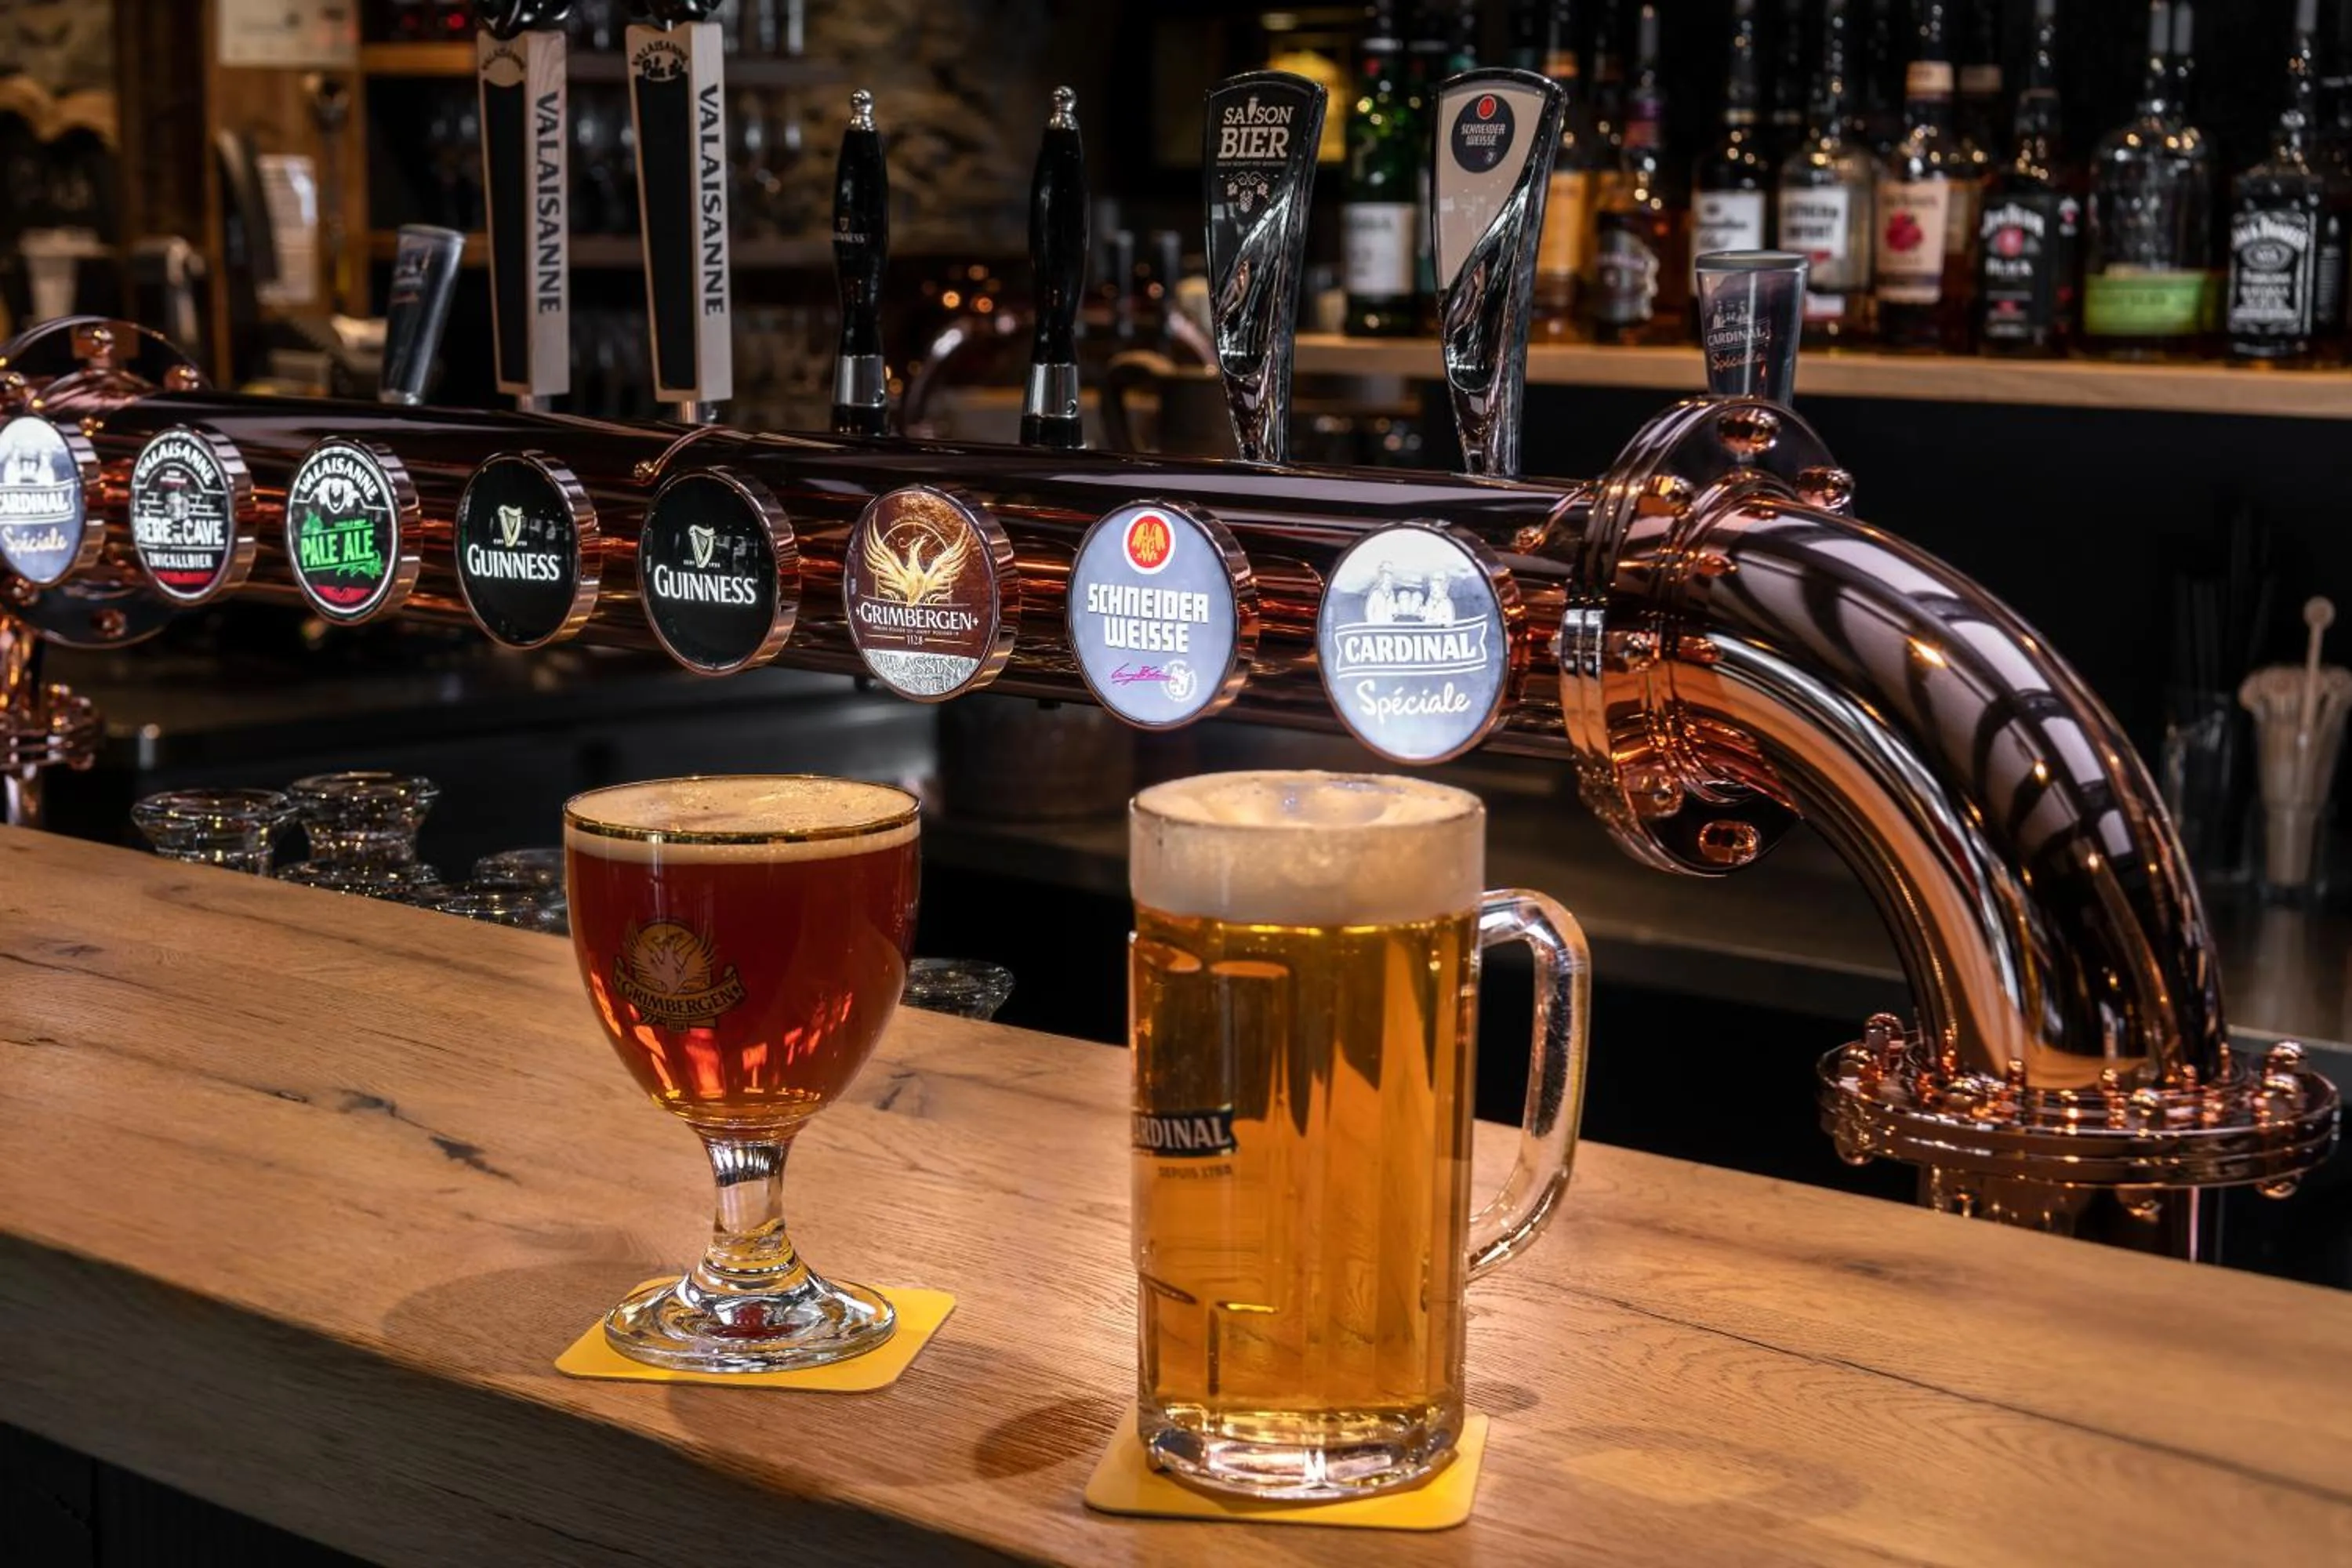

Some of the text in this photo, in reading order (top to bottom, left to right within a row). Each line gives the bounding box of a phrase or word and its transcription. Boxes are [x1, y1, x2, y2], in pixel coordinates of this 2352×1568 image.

[1223, 99, 1294, 125] SAISON
[1461, 123, 1506, 136] SCHNEIDER
[1218, 126, 1290, 158] BIER
[1465, 134, 1498, 147] WEISSE
[535, 91, 561, 314] VALAISANNE
[699, 83, 724, 316] VALAISANNE
[137, 441, 216, 485] VALAISANNE
[299, 456, 379, 502] VALAISANNE
[183, 518, 224, 545] CAVE
[300, 529, 375, 567] PALE ALE
[467, 543, 561, 581] GUINNESS
[654, 564, 757, 604] GUINNESS
[861, 601, 972, 631] GRIMBERGEN
[1087, 583, 1209, 623] SCHNEIDER
[1104, 616, 1189, 653] WEISSE
[1345, 632, 1476, 663] CARDINAL
[1356, 678, 1472, 724] Spéciale
[622, 981, 735, 1014] GRIMBERGEN
